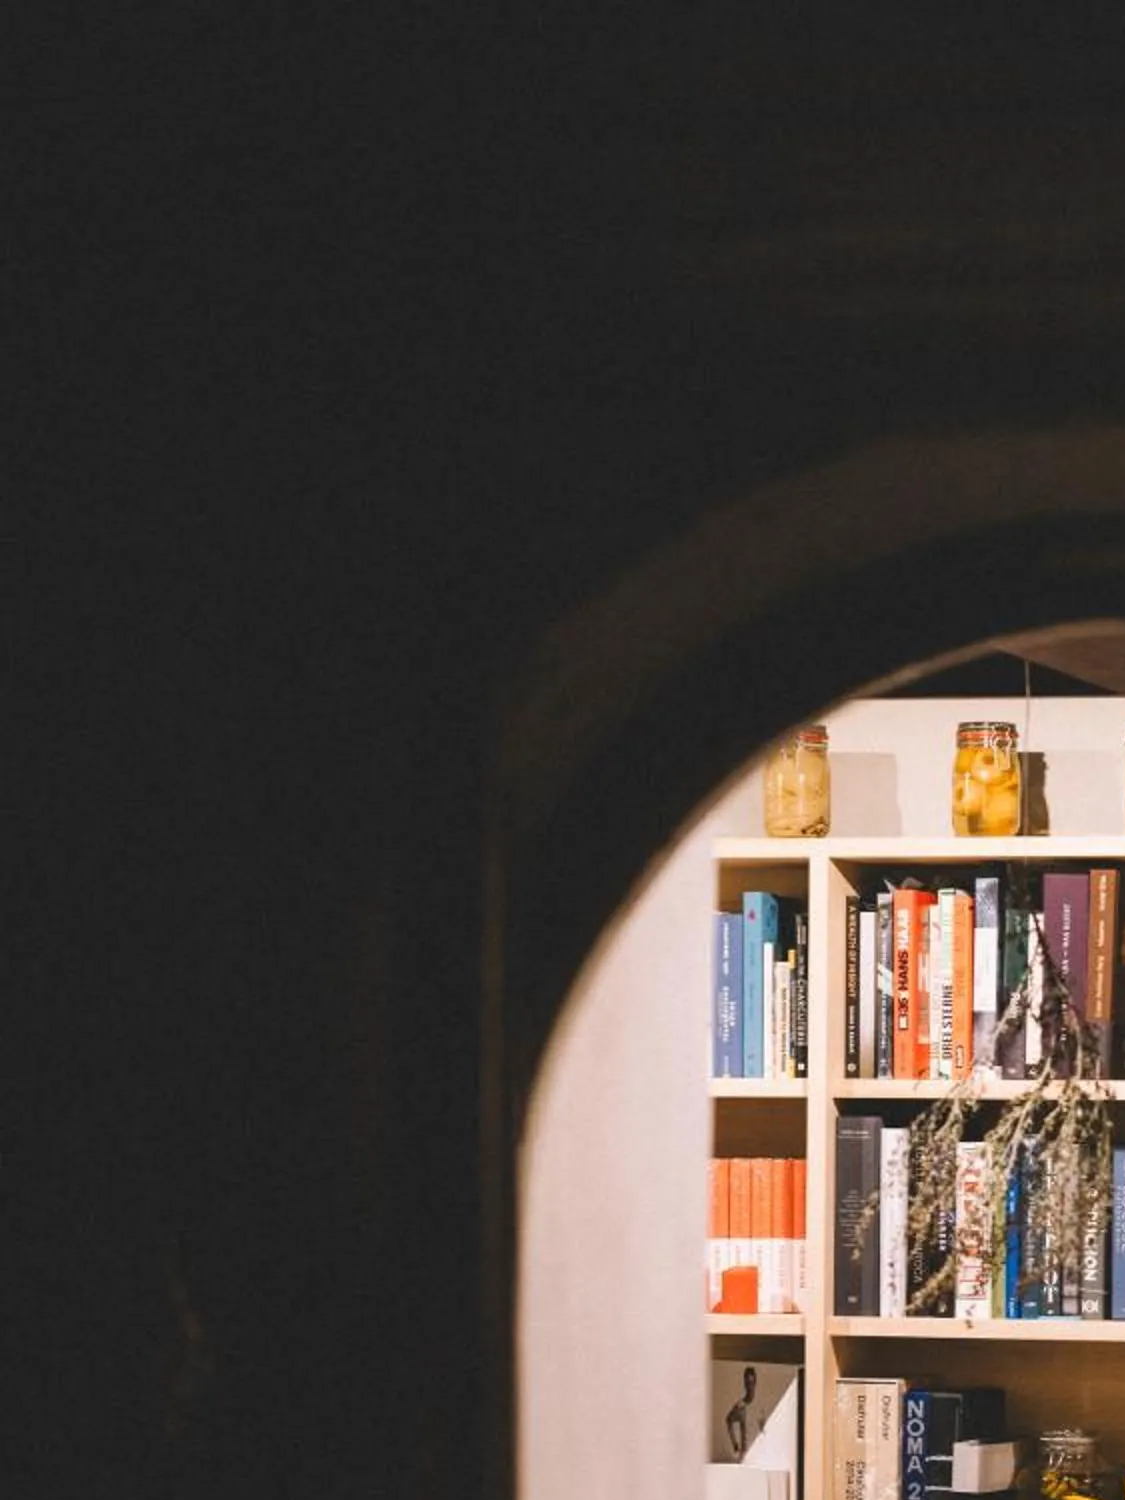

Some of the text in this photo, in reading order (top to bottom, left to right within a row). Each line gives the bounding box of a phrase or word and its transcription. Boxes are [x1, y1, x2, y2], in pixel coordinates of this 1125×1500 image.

[847, 918, 857, 948] WEALTH
[898, 950, 909, 991] HANS
[941, 984, 953, 1029] STERNE
[856, 1395, 866, 1439] Disfrutar
[881, 1395, 892, 1441] Disfrutar
[906, 1399, 925, 1474] NOMA
